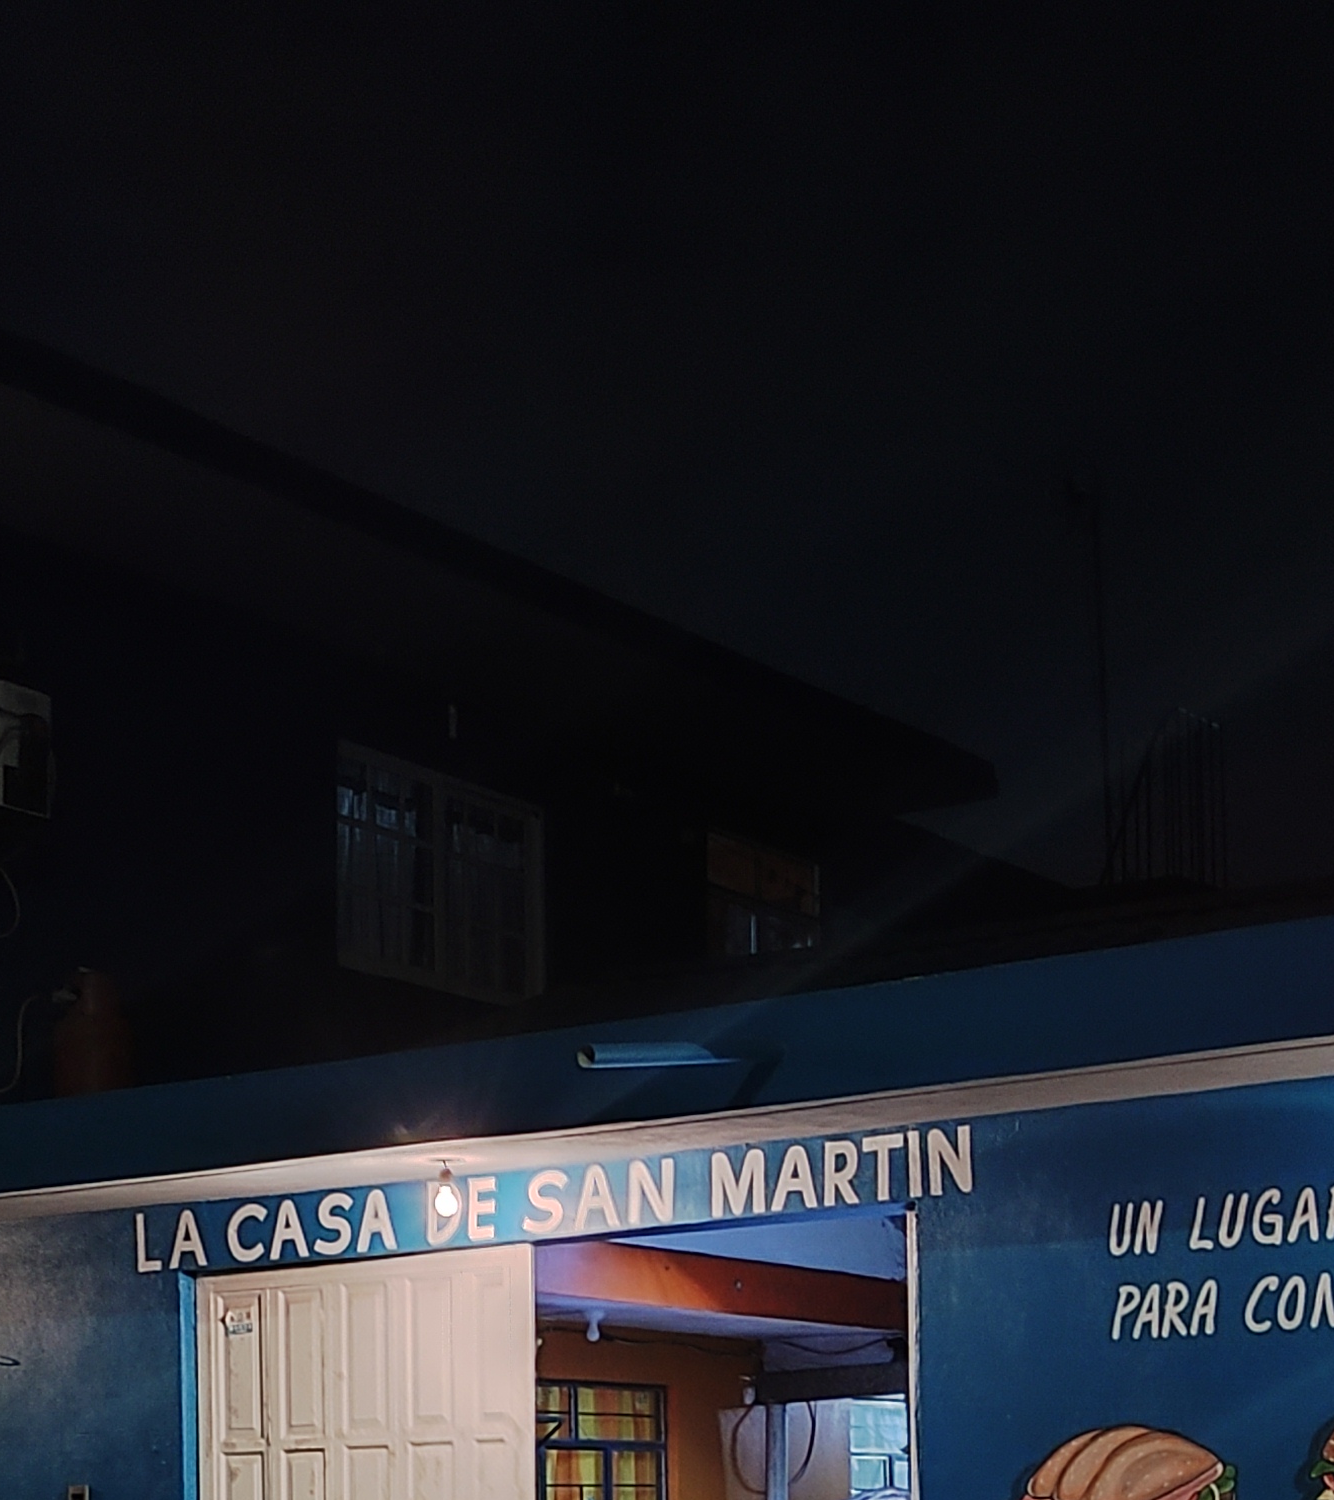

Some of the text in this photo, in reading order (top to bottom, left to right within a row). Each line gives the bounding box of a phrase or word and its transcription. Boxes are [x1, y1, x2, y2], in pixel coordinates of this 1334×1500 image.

[134, 1124, 973, 1274] LA CASA DE SAN MARTIN
[1108, 1199, 1164, 1257] UN
[1111, 1278, 1218, 1341] PARA
